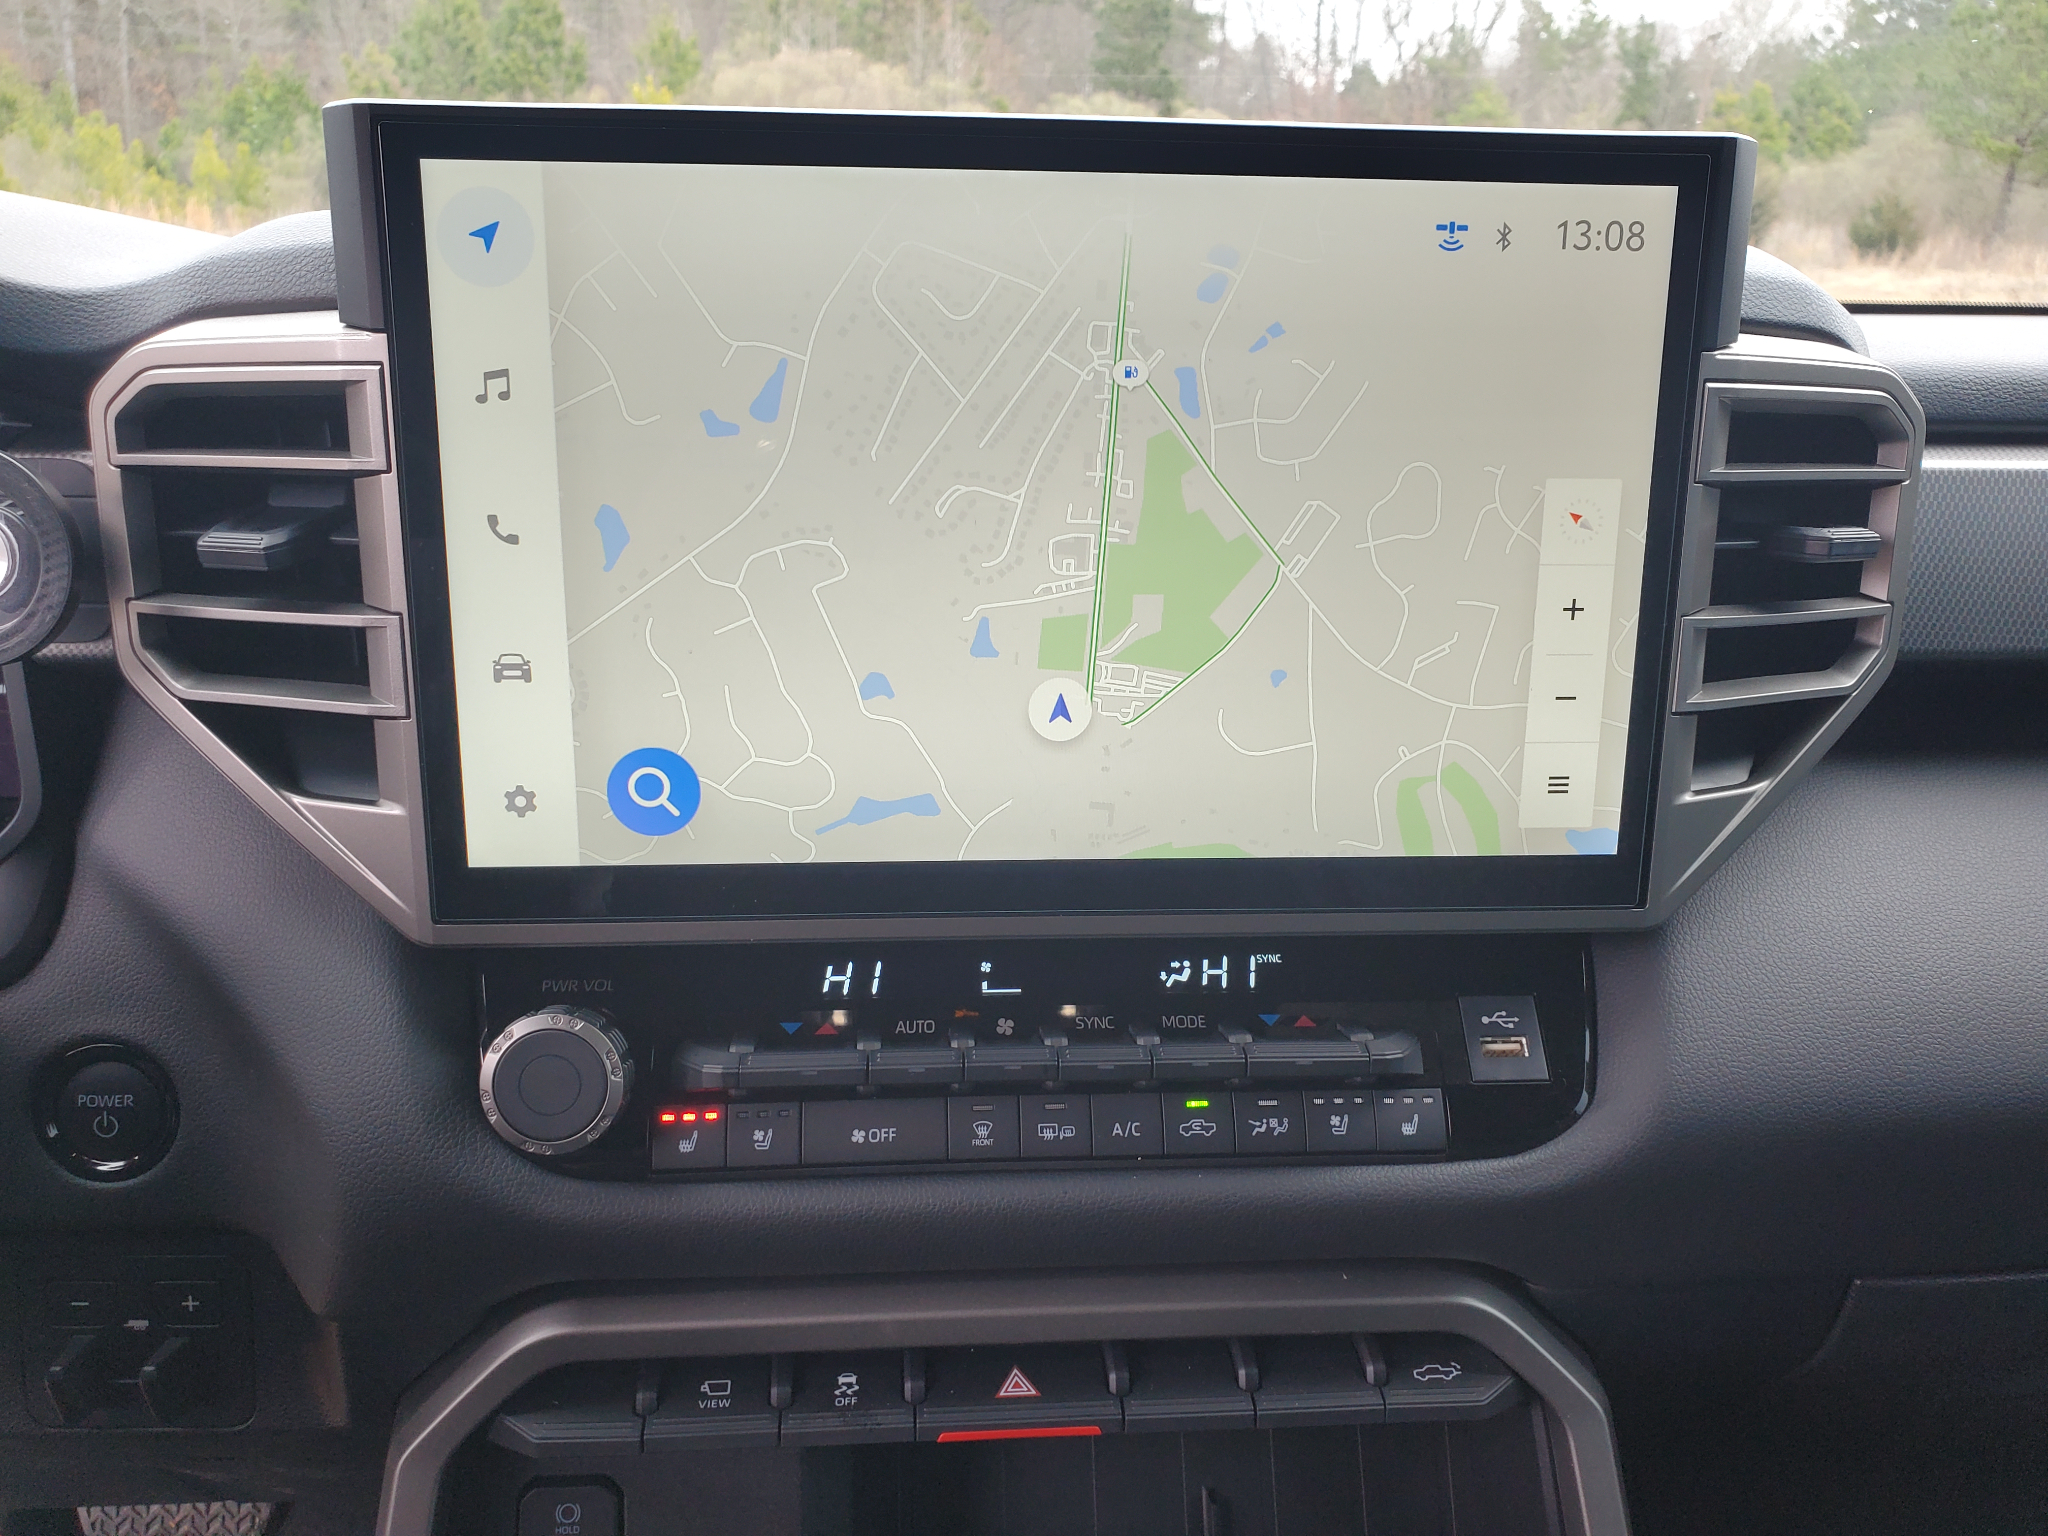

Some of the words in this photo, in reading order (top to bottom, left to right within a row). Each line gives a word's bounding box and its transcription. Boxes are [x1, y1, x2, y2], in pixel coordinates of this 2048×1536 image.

[1556, 219, 1646, 252] 13:08
[1256, 953, 1283, 964] SYNC
[541, 978, 579, 993] PWR
[582, 978, 614, 993] VOL
[895, 1020, 935, 1034] AUTO
[1075, 1016, 1115, 1030] SYNC
[1162, 1015, 1207, 1030] MODE
[77, 1094, 134, 1108] POWER
[868, 1127, 897, 1143] OFF
[1111, 1122, 1142, 1138] A/C
[971, 1138, 994, 1147] FRONT
[698, 1398, 732, 1410] VIEW
[834, 1397, 858, 1407] OFF
[555, 1525, 581, 1535] HOLD
